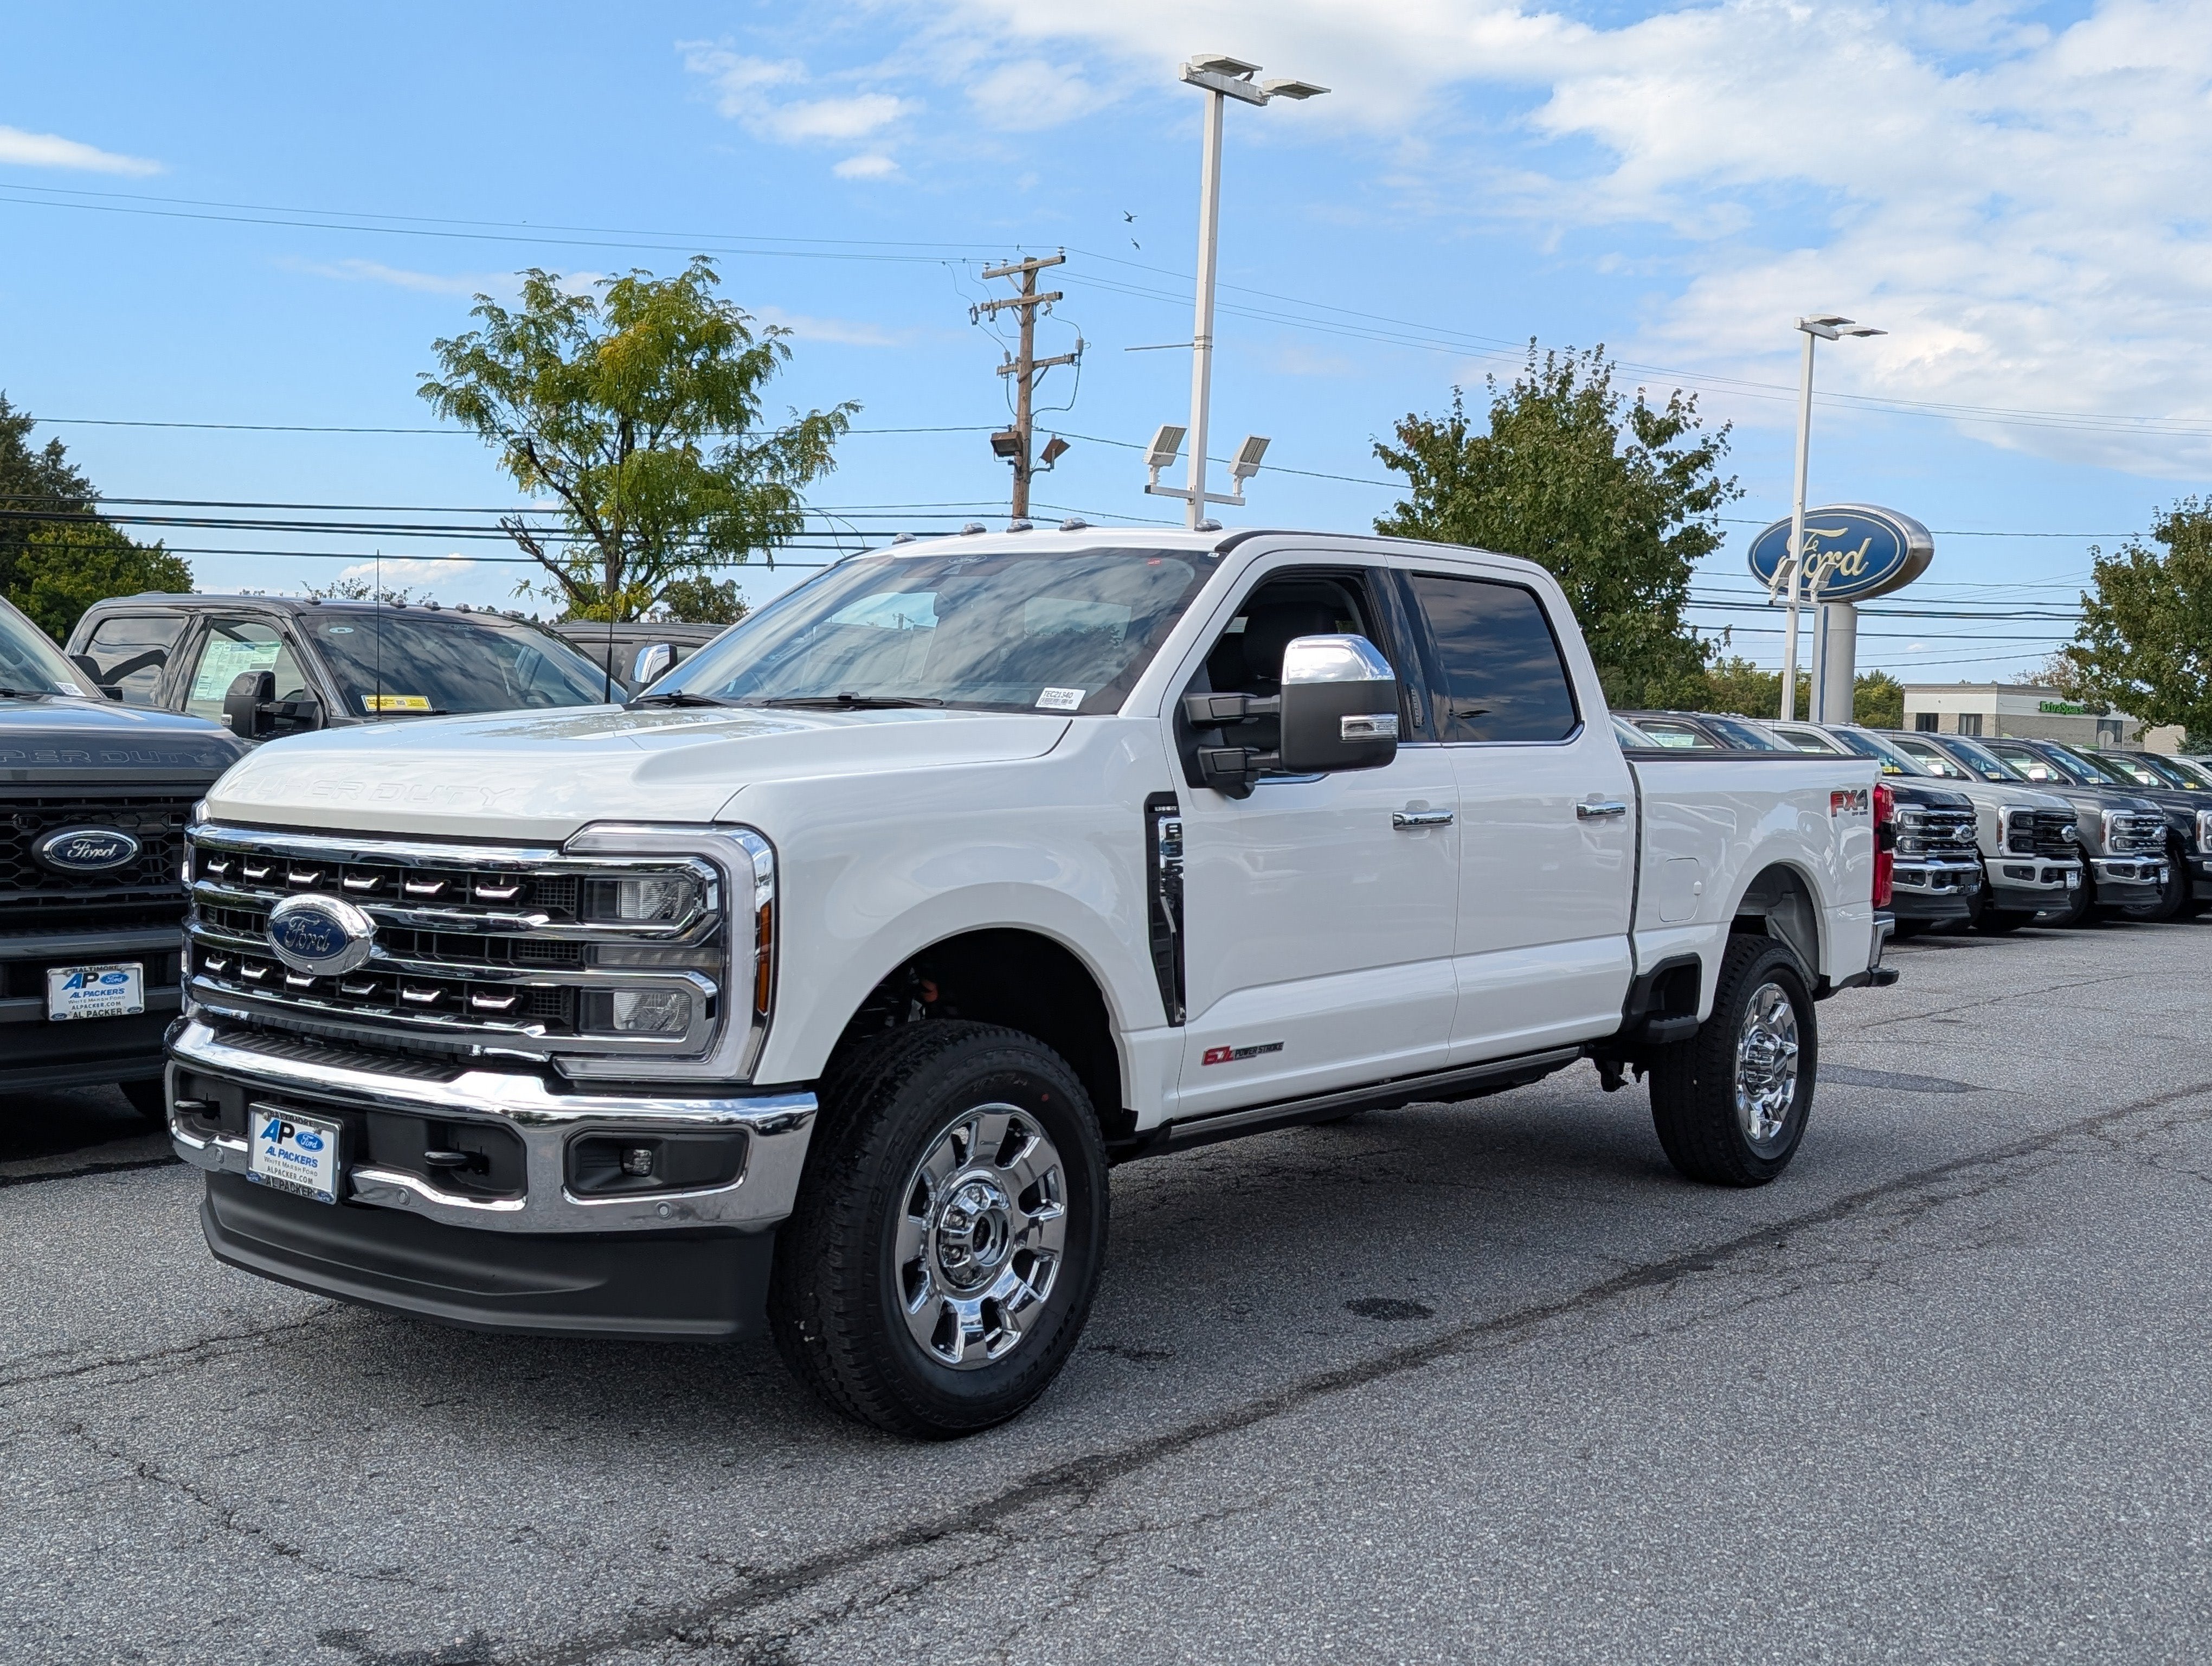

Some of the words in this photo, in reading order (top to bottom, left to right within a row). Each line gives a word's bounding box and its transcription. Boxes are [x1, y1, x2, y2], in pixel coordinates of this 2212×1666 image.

[1777, 527, 1872, 579] Ford
[99, 751, 207, 763] DUTY
[368, 783, 516, 806] DUTY
[1830, 789, 1868, 818] FX4
[67, 838, 118, 858] Ford
[284, 917, 331, 952] Ford
[61, 972, 100, 990] AP
[107, 975, 124, 983] Ford
[72, 1011, 85, 1019] AL
[86, 1008, 123, 1018] PACKER
[260, 1119, 295, 1145] AP
[300, 1133, 318, 1148] Ford
[266, 1175, 278, 1188] AL
[279, 1179, 314, 1197] PACKER
